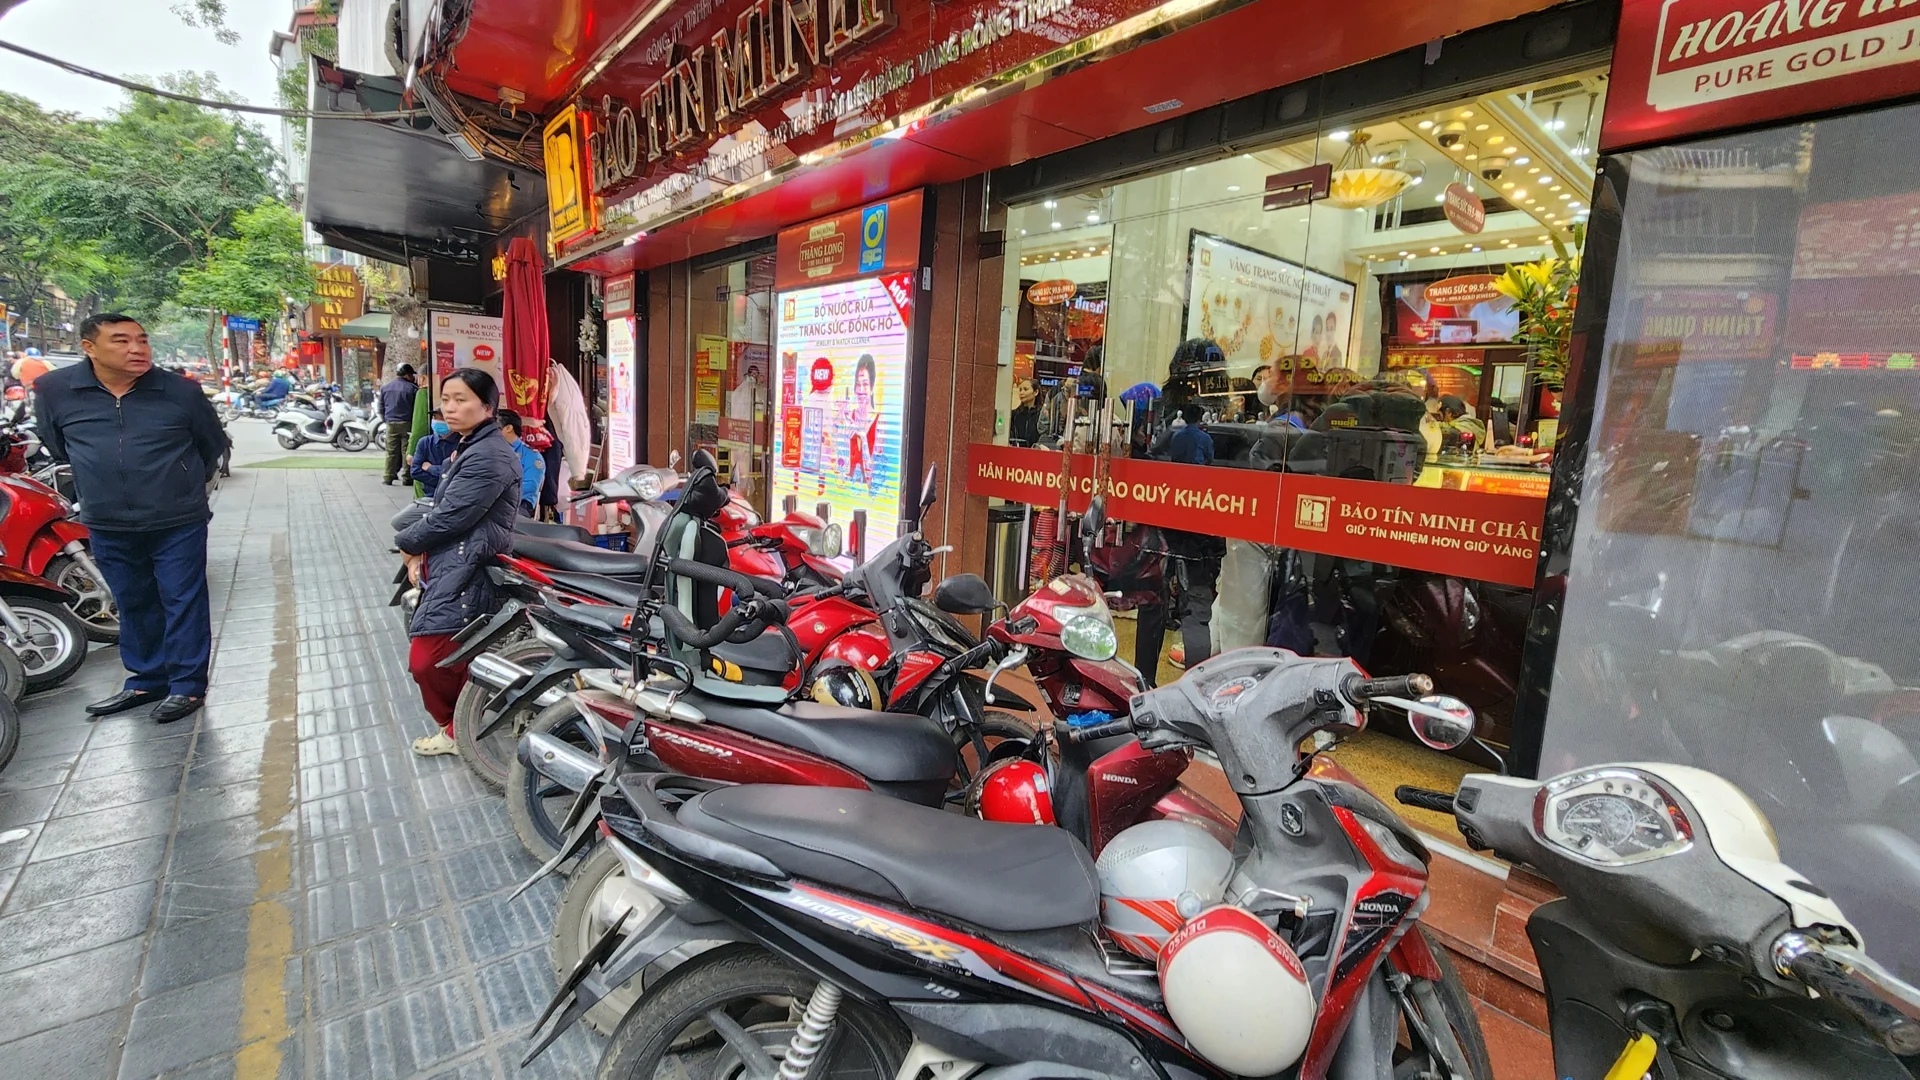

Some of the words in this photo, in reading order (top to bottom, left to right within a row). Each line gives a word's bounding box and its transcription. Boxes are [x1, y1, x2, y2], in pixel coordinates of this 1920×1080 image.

[1694, 59, 1774, 93] PURE
[1786, 37, 1885, 73] GOLD
[640, 43, 705, 162] TÍN
[800, 245, 823, 261] THĂNG
[824, 241, 843, 256] LONG
[1229, 257, 1251, 275] VÀNG
[888, 279, 910, 309] MỚI
[1429, 286, 1453, 297] TRANG
[1453, 283, 1467, 294] SỨC
[814, 306, 826, 321] BỘ
[828, 299, 854, 316] NƯỚC
[855, 296, 874, 312] RỬA
[456, 328, 480, 336] TRANG
[799, 325, 826, 337] TRANG
[848, 317, 876, 333] ĐỒNG
[877, 312, 893, 331] HỒ
[476, 349, 492, 357] NEW
[814, 369, 830, 380] NEW
[978, 462, 1003, 481] HÂN
[1006, 466, 1043, 486] HOAN
[1132, 482, 1171, 506] QUÝ
[1174, 487, 1246, 515] KHÁCH
[1250, 497, 1258, 517] !
[1340, 502, 1378, 521] BẢO
[1381, 505, 1415, 525] TÍN
[1419, 512, 1476, 534] MINH
[1480, 519, 1541, 543] CHÂU
[1345, 522, 1367, 537] GIỮ
[1369, 525, 1387, 539] TÍN
[1389, 529, 1429, 546] NHIỆM
[1431, 534, 1459, 549] HƠN
[1464, 539, 1490, 554] GIỮ
[1492, 541, 1533, 560] VÀNG
[906, 654, 934, 666] HONDA
[1101, 773, 1139, 786] HONDA
[1358, 902, 1399, 914] HONDA
[1168, 918, 1207, 955] DENSO
